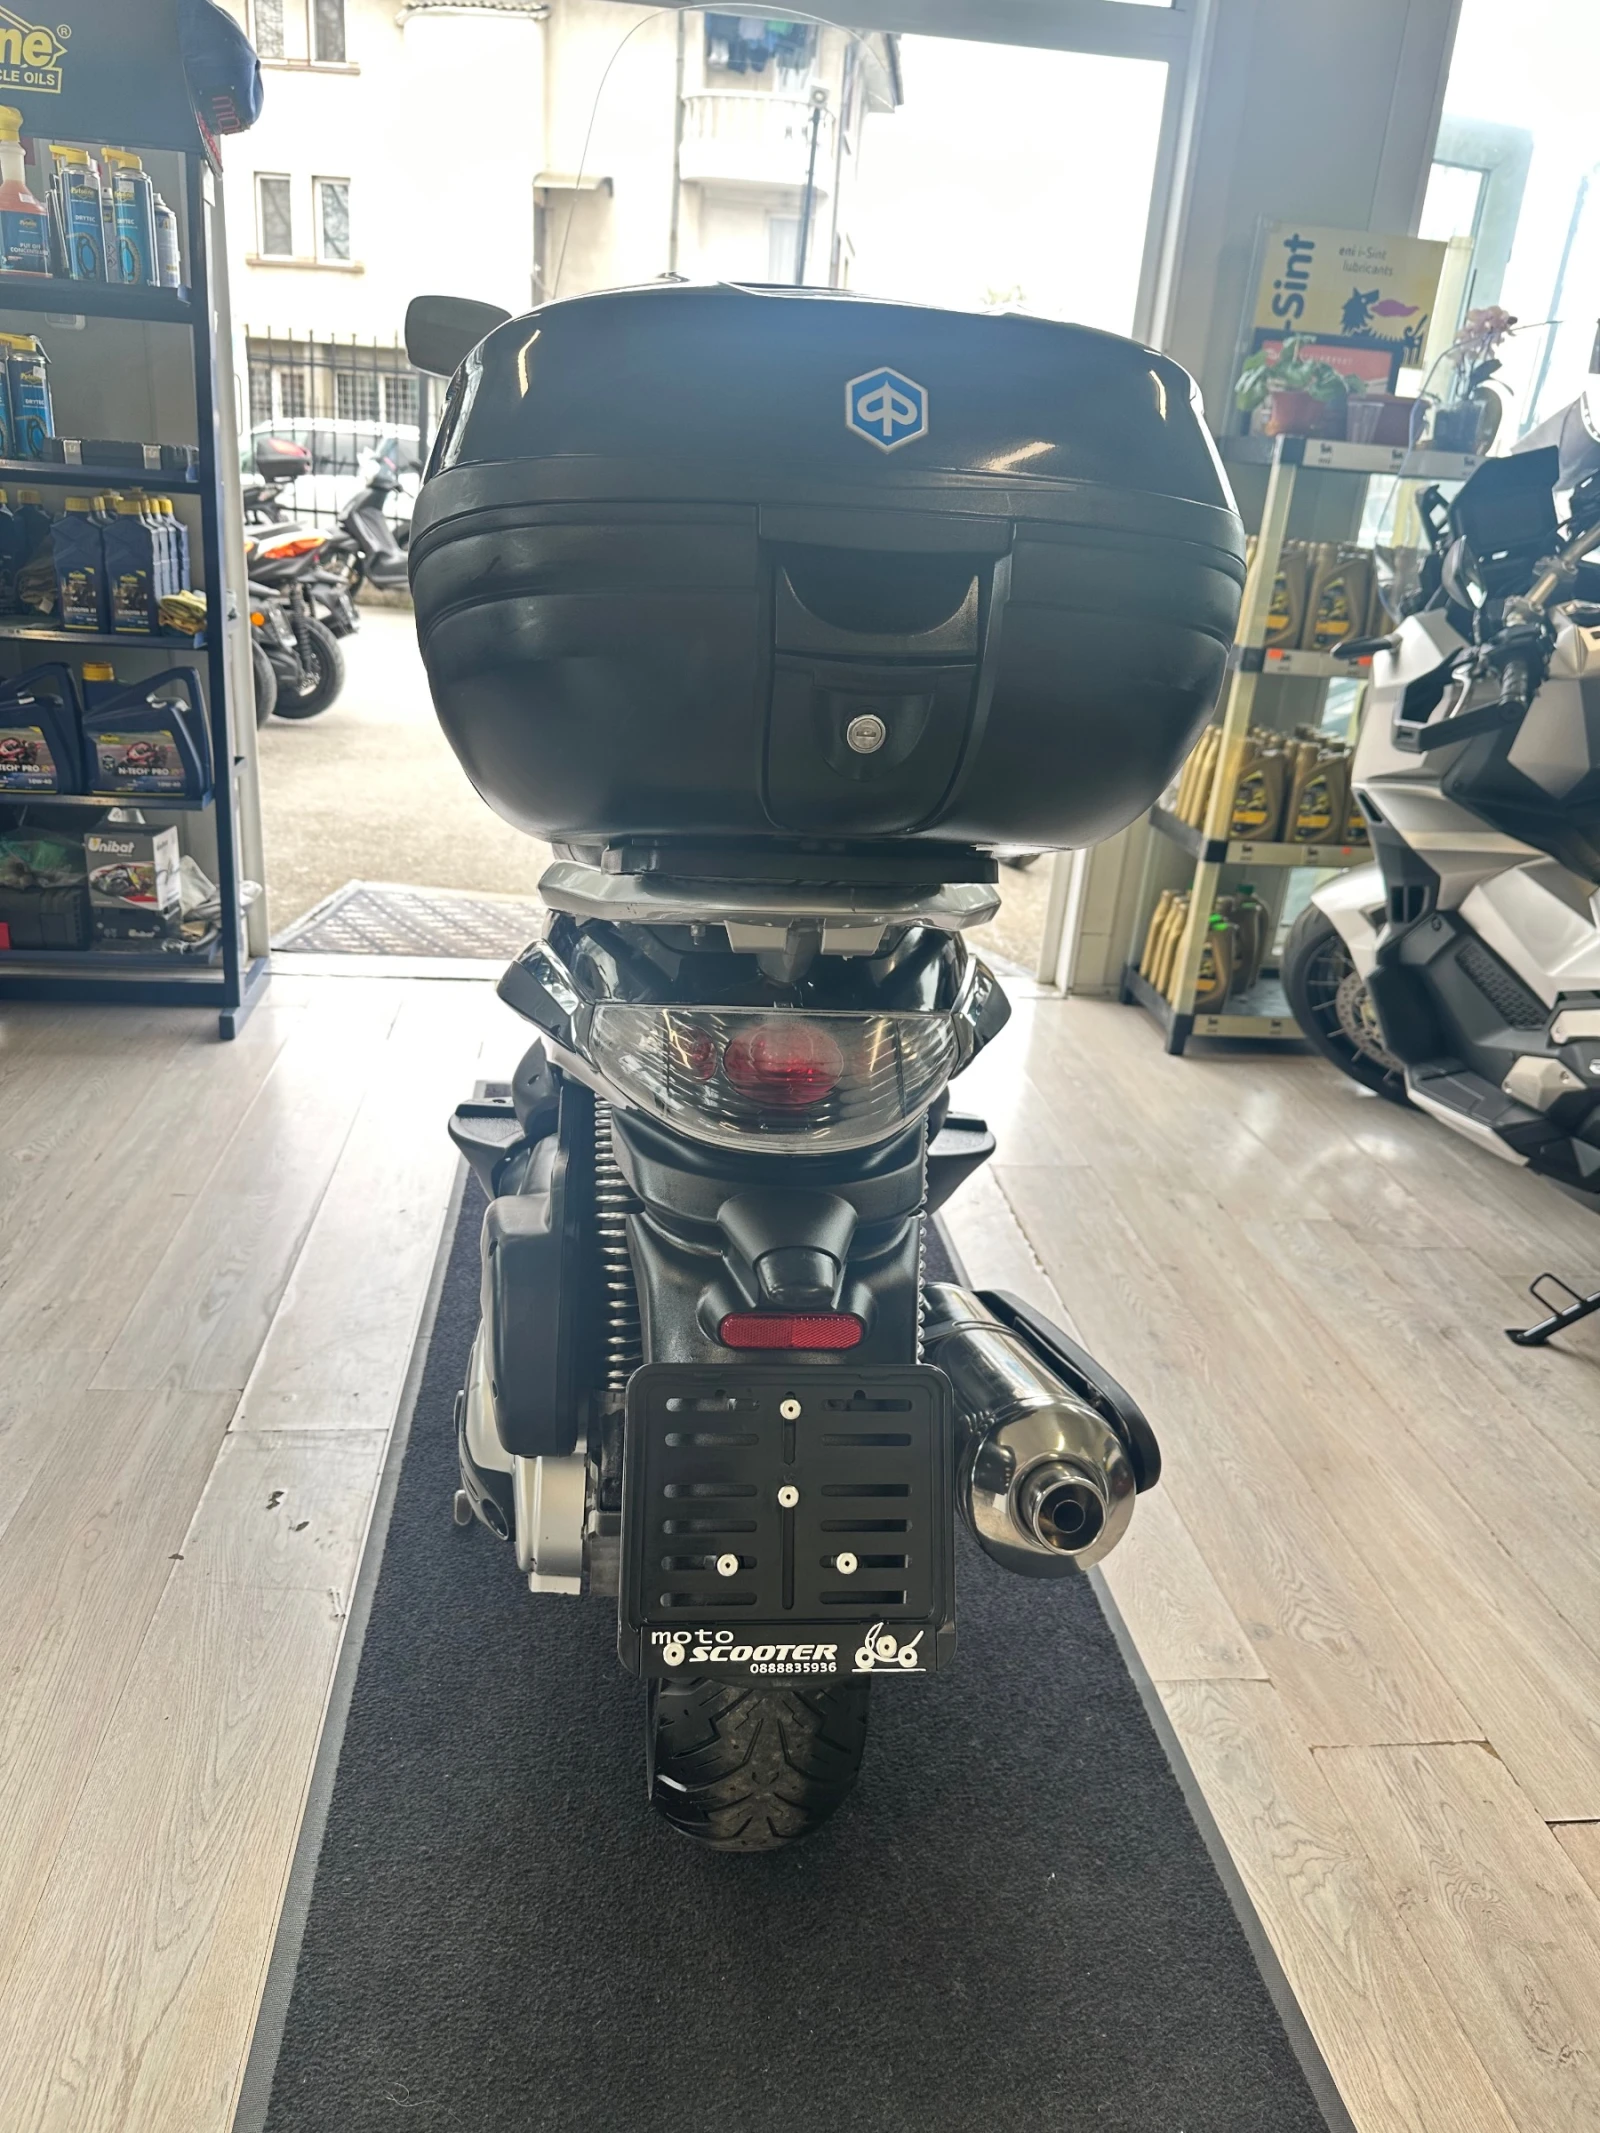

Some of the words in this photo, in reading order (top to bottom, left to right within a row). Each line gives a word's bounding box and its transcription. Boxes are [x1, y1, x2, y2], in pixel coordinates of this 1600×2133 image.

[0, 69, 20, 83] LE
[24, 71, 55, 86] OILS
[1342, 259, 1394, 277] lubricants
[22, 763, 40, 773] PRO
[88, 837, 135, 853] Unibat
[651, 1629, 734, 1644] moto
[689, 1644, 838, 1663] SCOOTER
[750, 1662, 837, 1674] 0888835936
